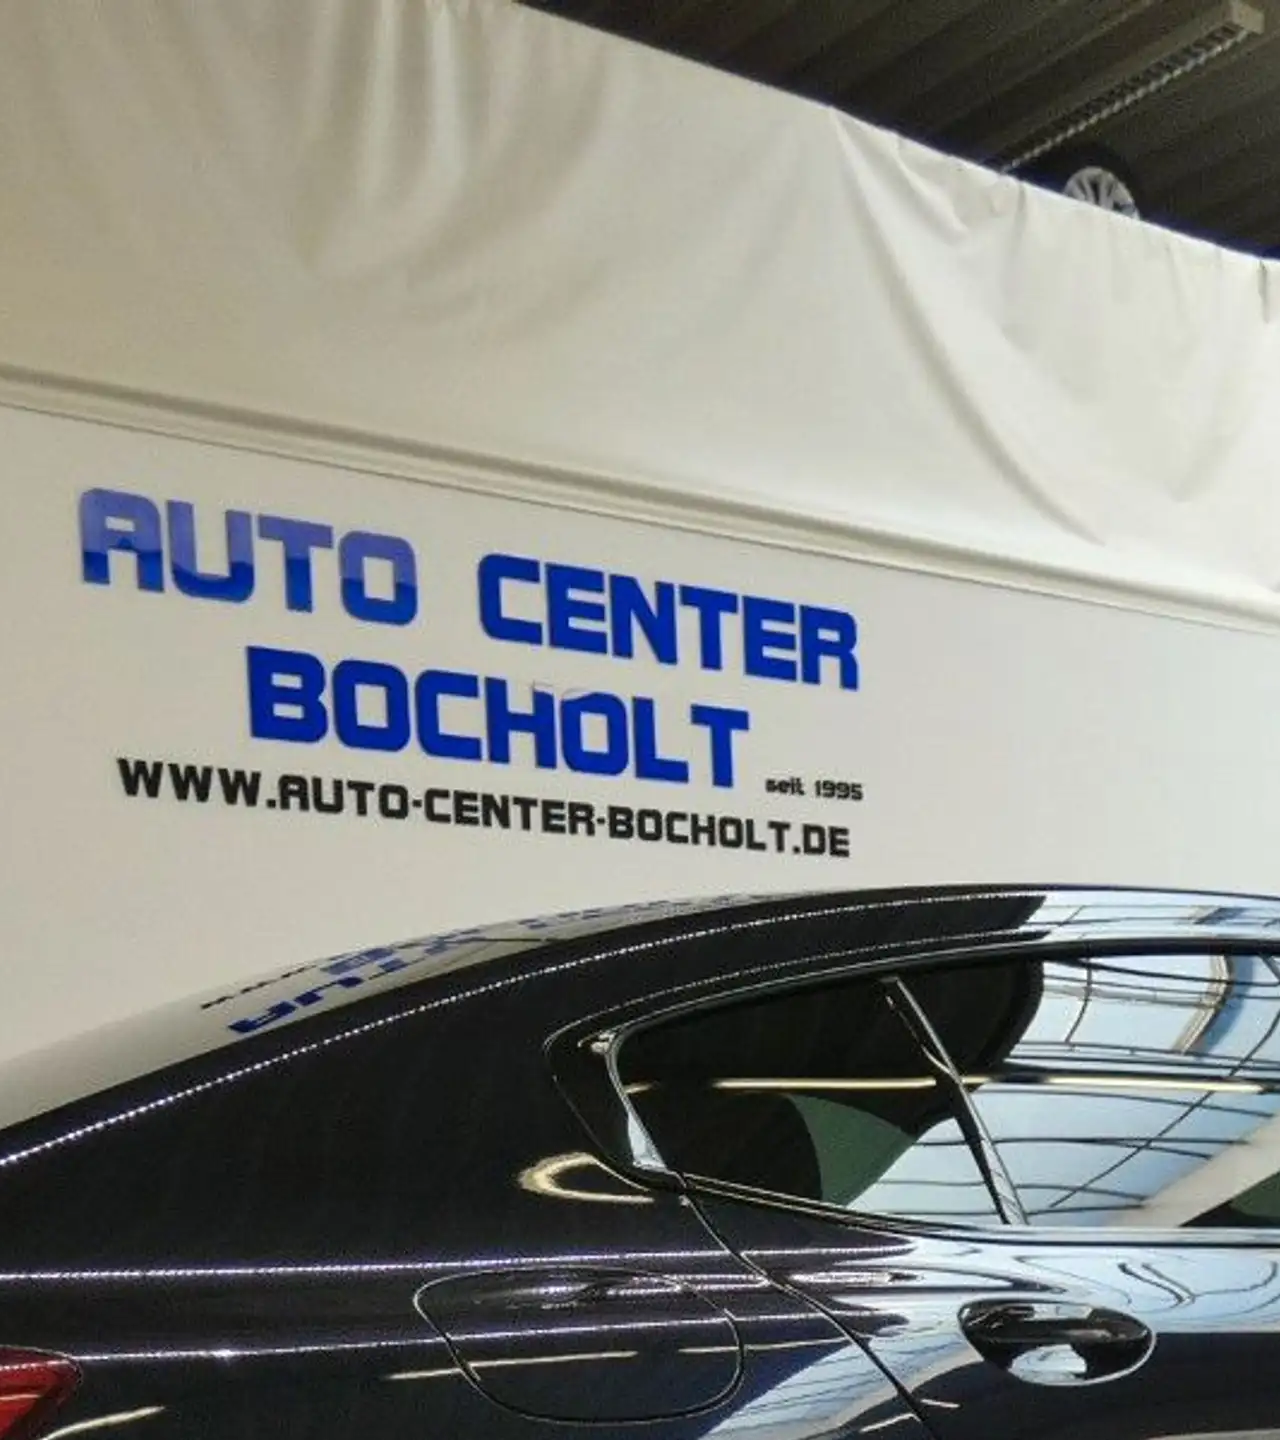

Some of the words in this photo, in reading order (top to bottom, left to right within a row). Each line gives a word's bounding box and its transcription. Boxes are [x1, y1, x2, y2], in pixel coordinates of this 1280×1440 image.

[80, 489, 419, 627] AUTO
[477, 552, 861, 692] CENTER
[247, 645, 751, 789] BOCHOLT
[117, 757, 851, 858] WWW.AUTO-CENTER-BOCHOLT.DE
[765, 777, 805, 797] seit
[814, 780, 863, 801] 1995
